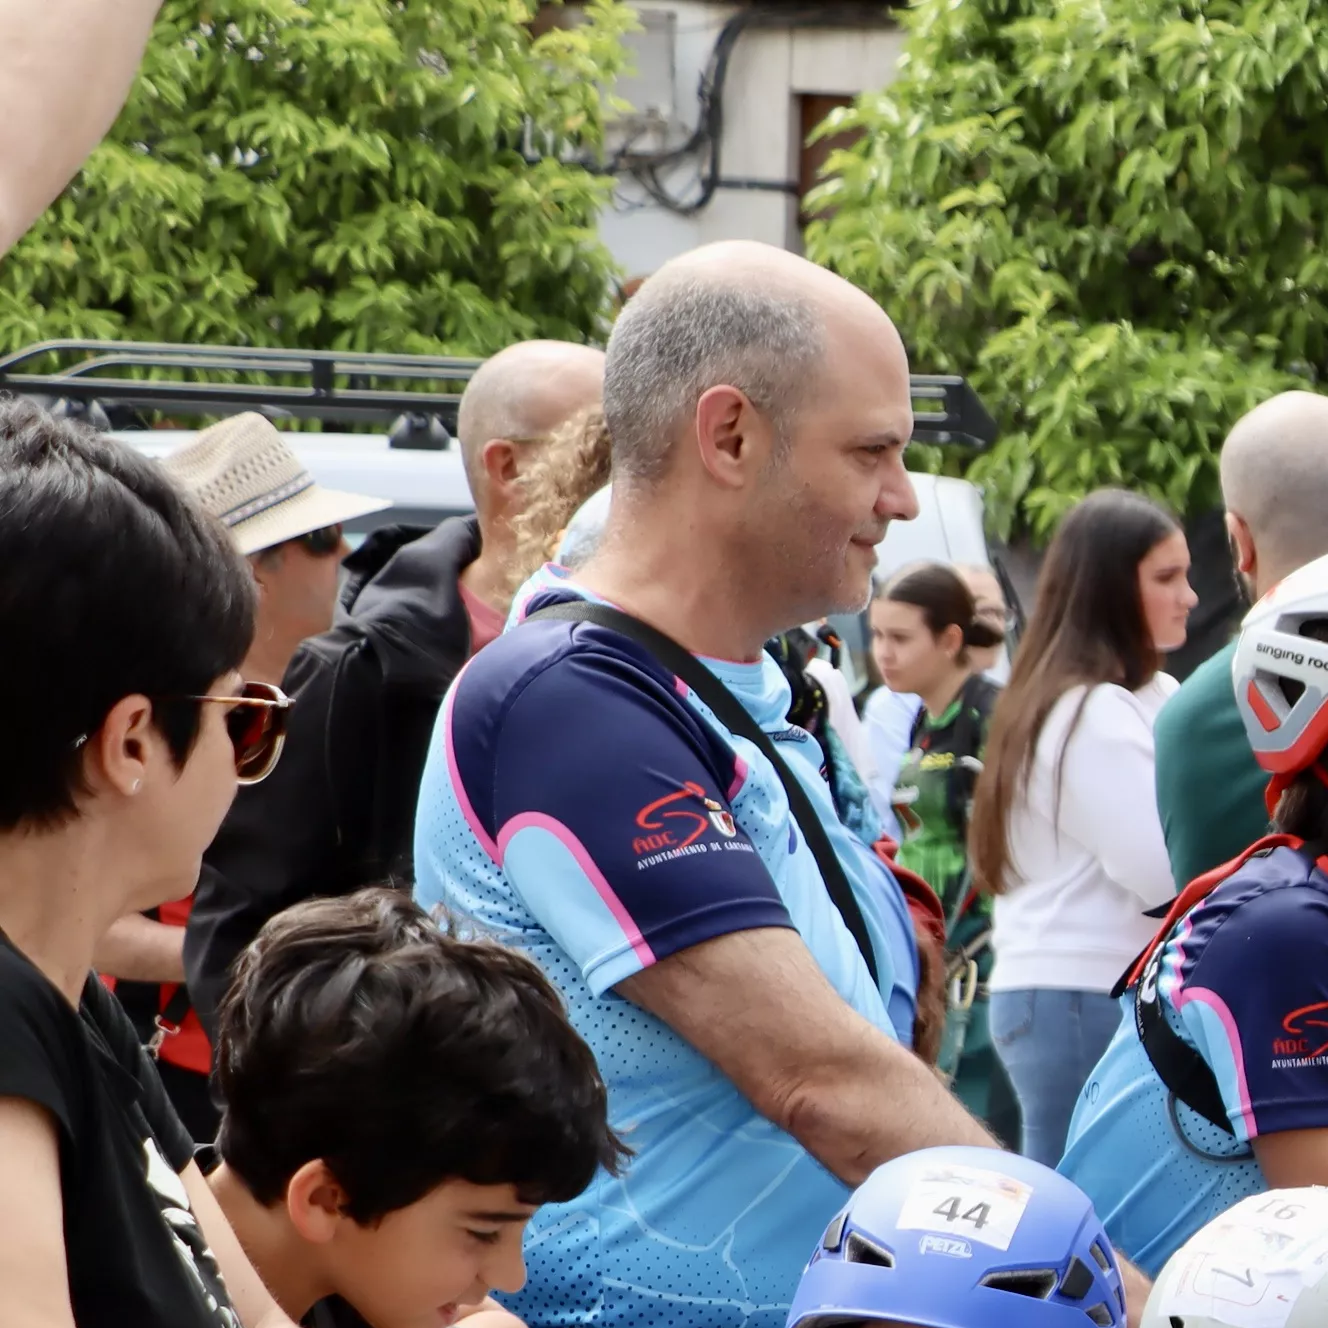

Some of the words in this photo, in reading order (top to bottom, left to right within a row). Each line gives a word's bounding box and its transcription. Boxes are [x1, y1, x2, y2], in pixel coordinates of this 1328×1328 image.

[637, 842, 708, 871] AYUNTAMIENTO
[710, 842, 722, 852] DE
[931, 1195, 992, 1230] 44
[920, 1235, 973, 1259] PETZL
